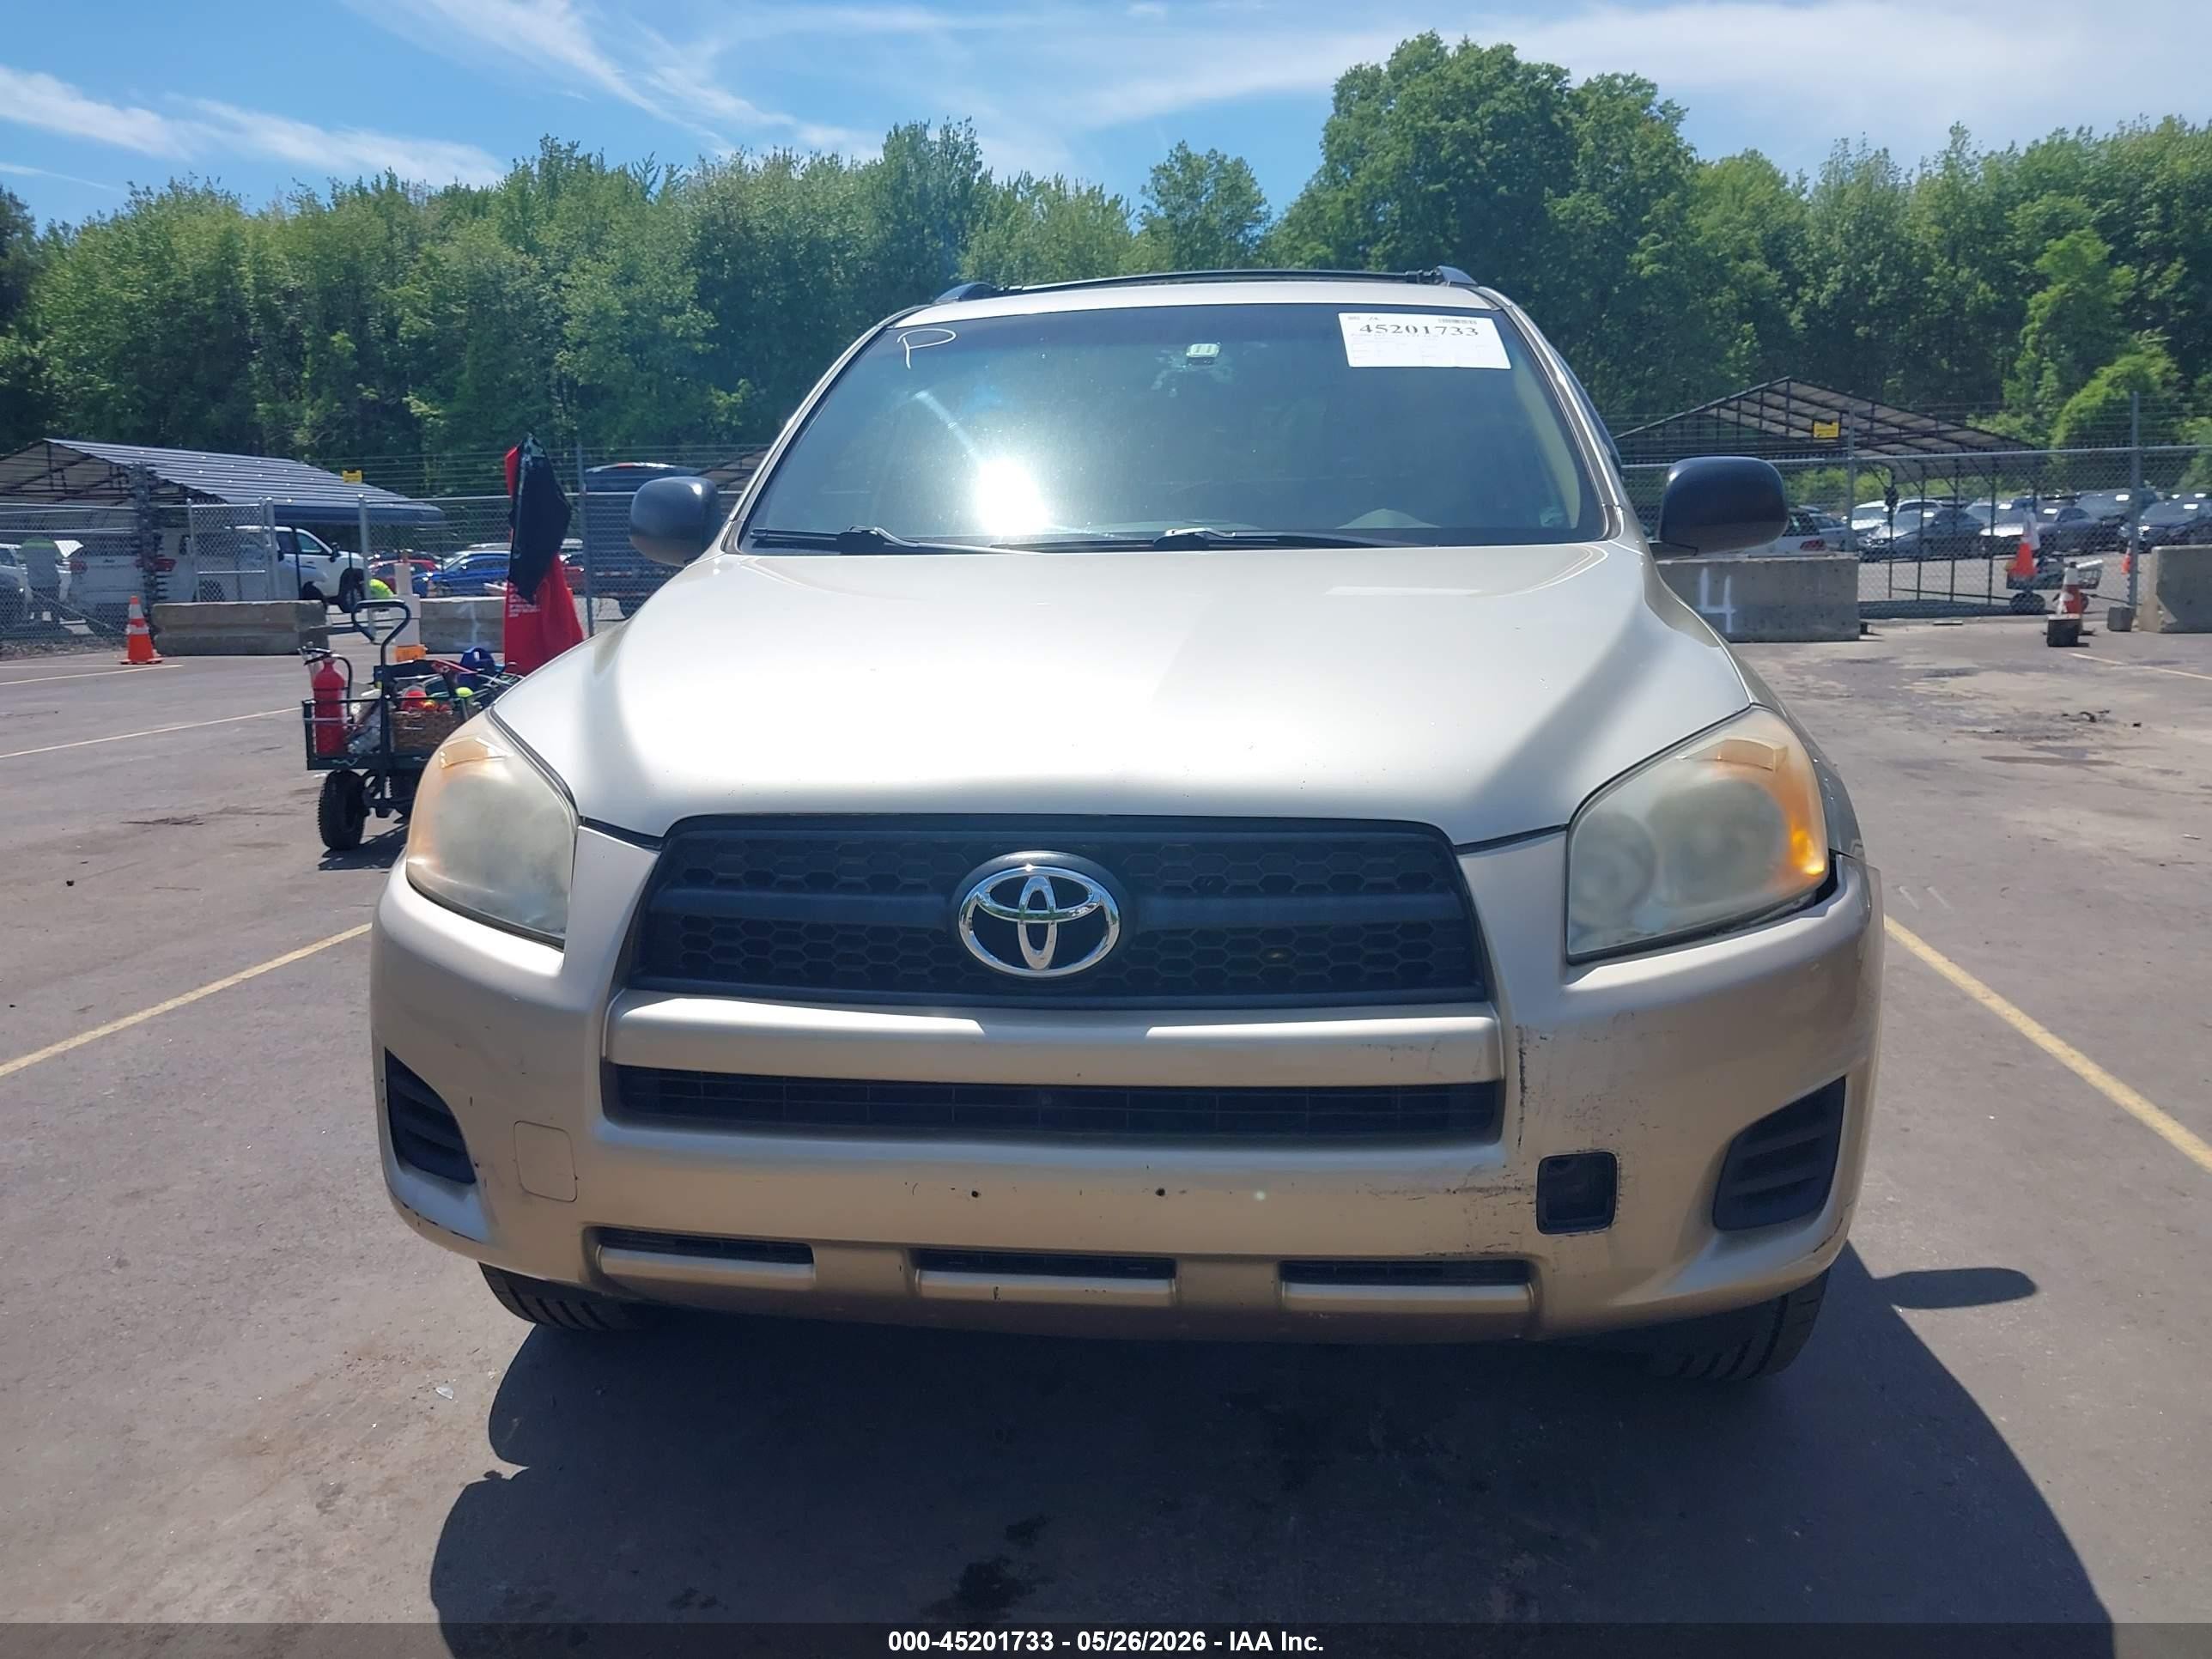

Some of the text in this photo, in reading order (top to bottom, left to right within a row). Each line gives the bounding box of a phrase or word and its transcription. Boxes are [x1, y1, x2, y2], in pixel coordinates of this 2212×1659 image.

[896, 328, 957, 369] P
[1359, 324, 1479, 337] 45201733
[1698, 567, 1736, 633] 4
